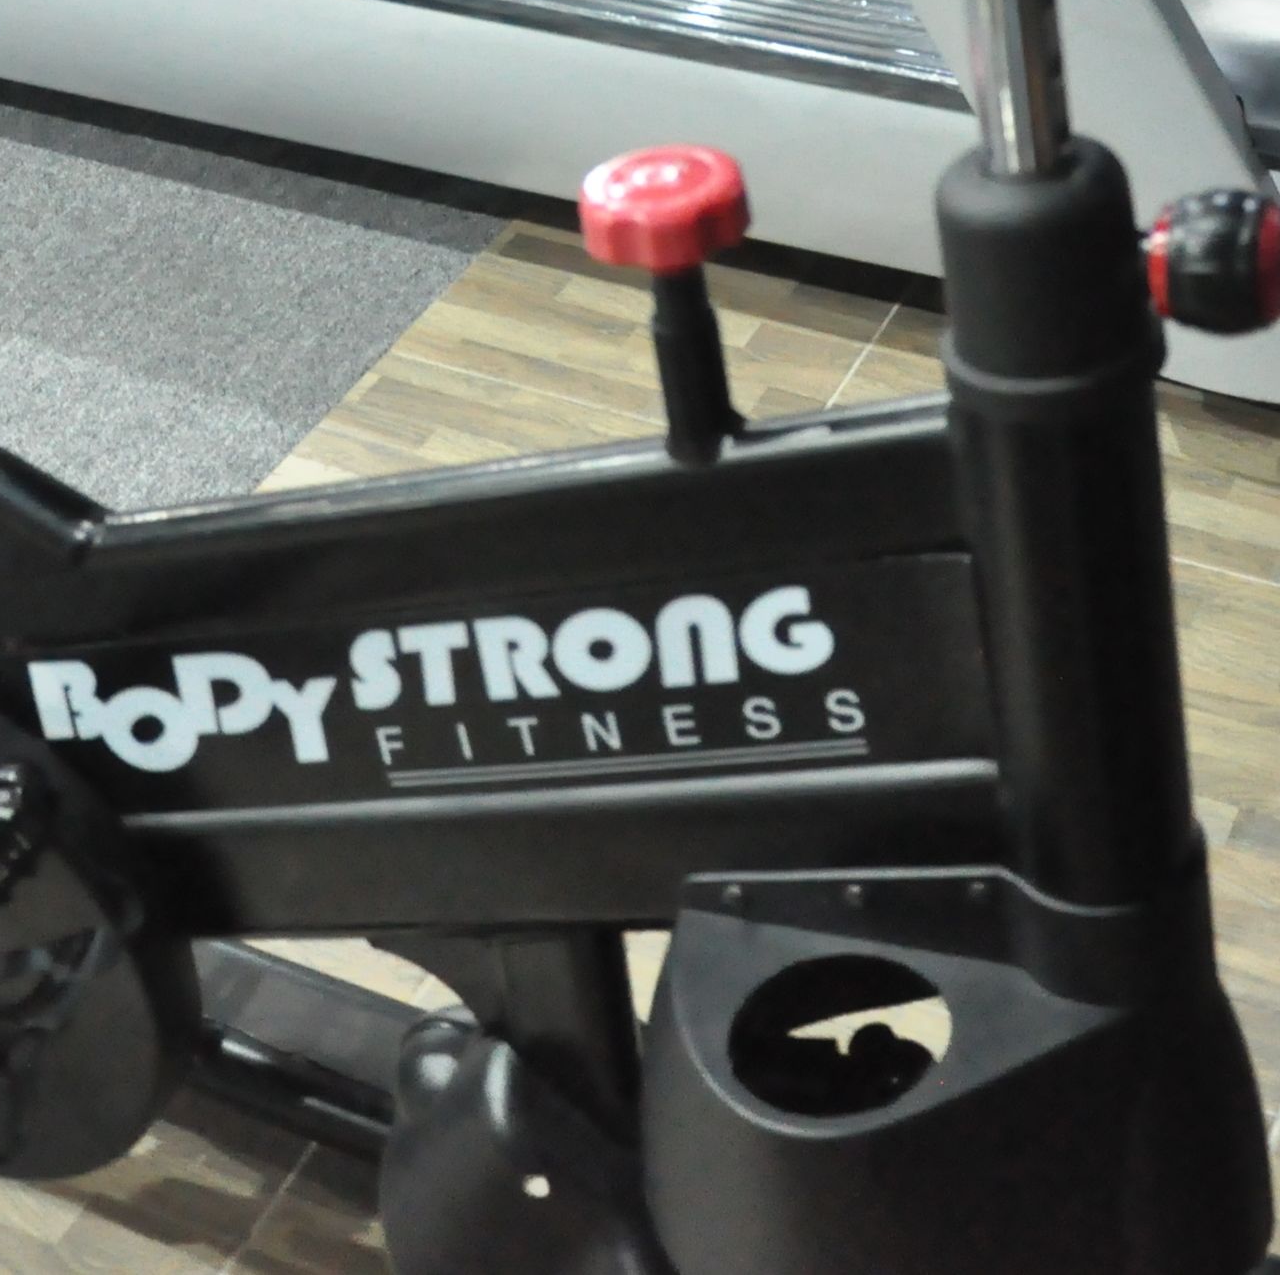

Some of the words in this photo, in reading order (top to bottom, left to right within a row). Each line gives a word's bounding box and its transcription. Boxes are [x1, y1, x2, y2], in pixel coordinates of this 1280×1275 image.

[27, 651, 337, 773] BODY
[349, 585, 835, 711] STRONG
[375, 689, 865, 766] FITNESS
